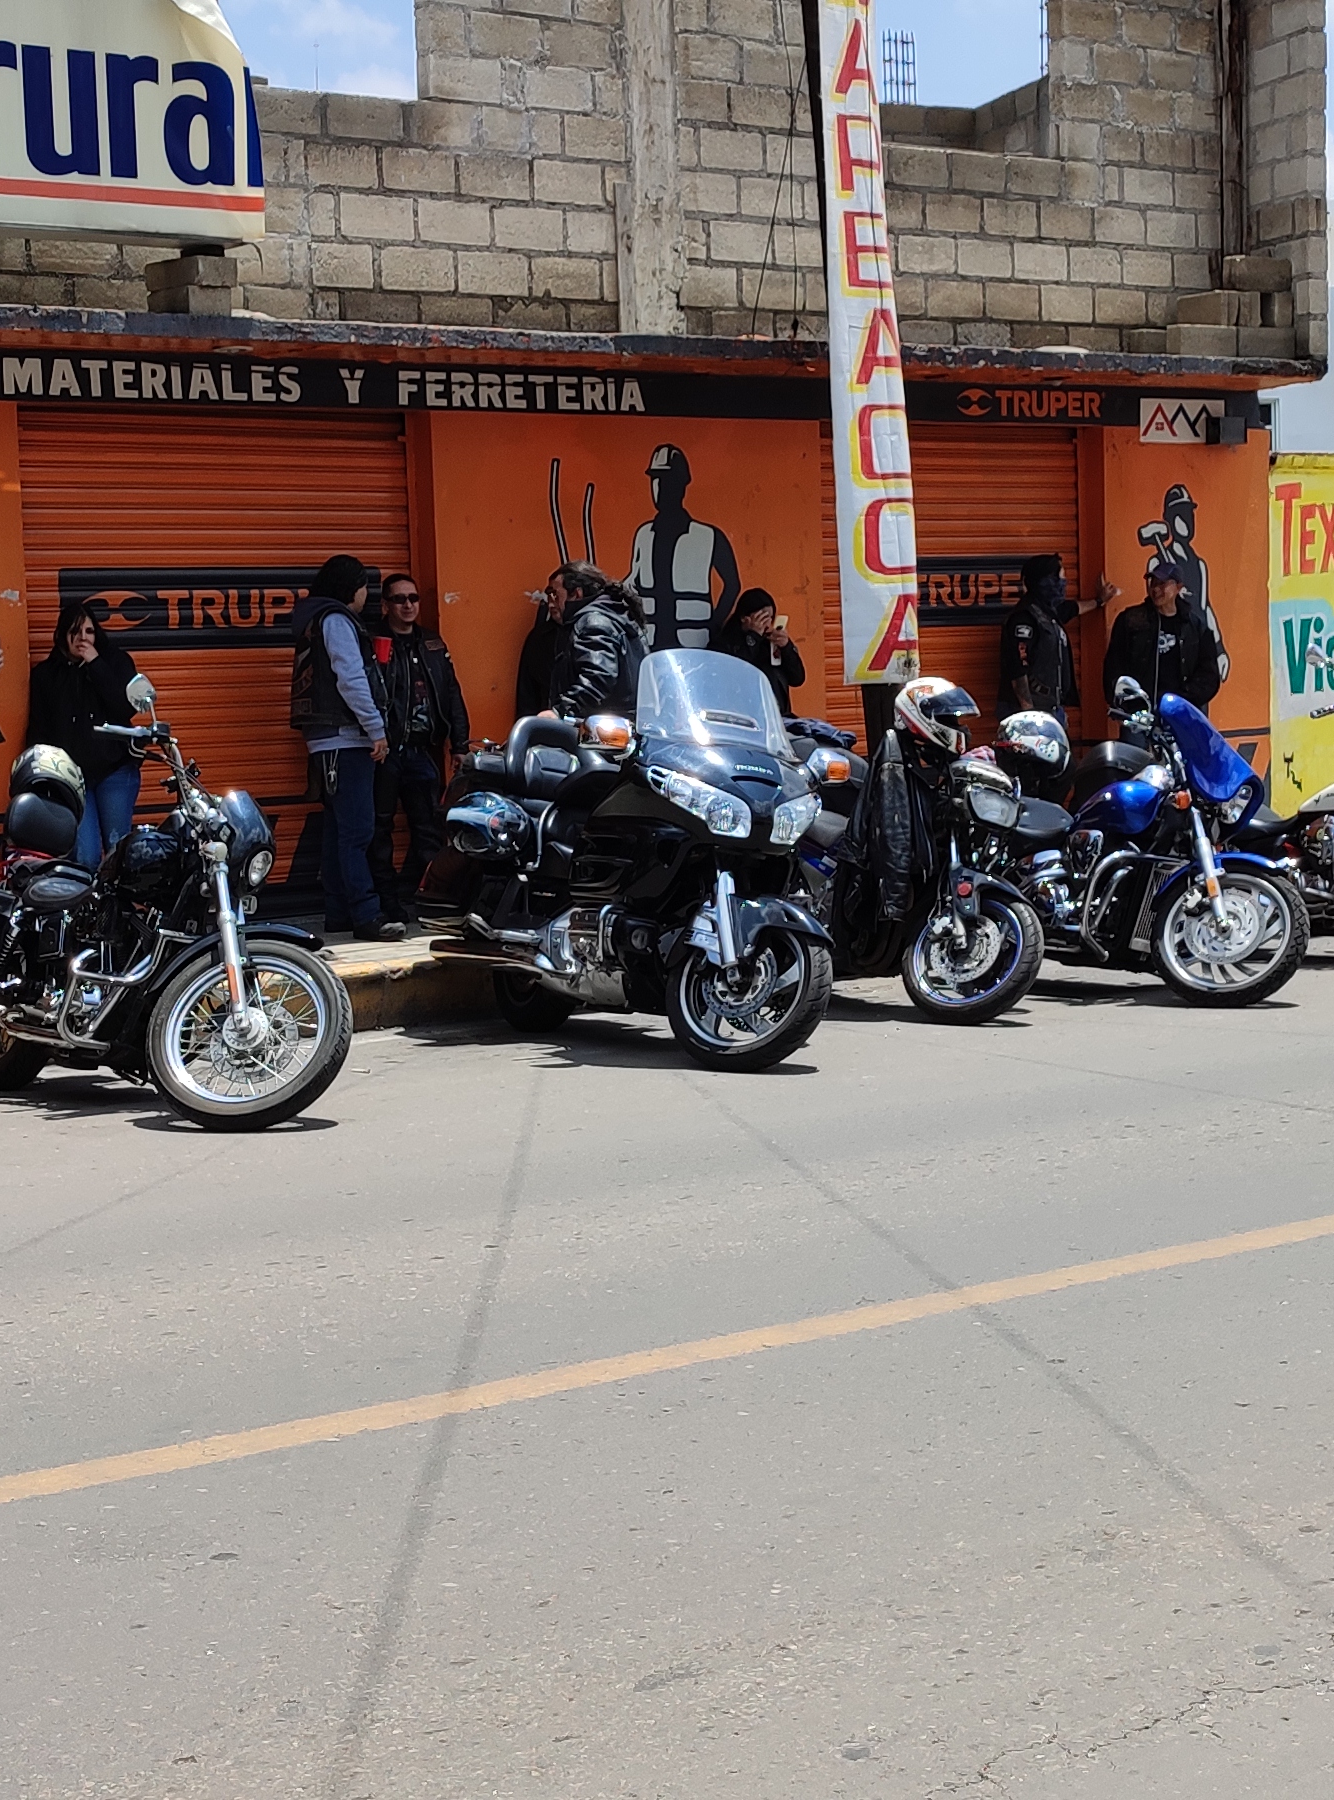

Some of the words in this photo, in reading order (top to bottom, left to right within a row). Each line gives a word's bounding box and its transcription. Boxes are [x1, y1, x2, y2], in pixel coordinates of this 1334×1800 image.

[2, 356, 302, 403] MATERIALES
[338, 367, 365, 405] Y
[398, 369, 646, 412] FERRETERIA
[995, 390, 1101, 418] TRUPER
